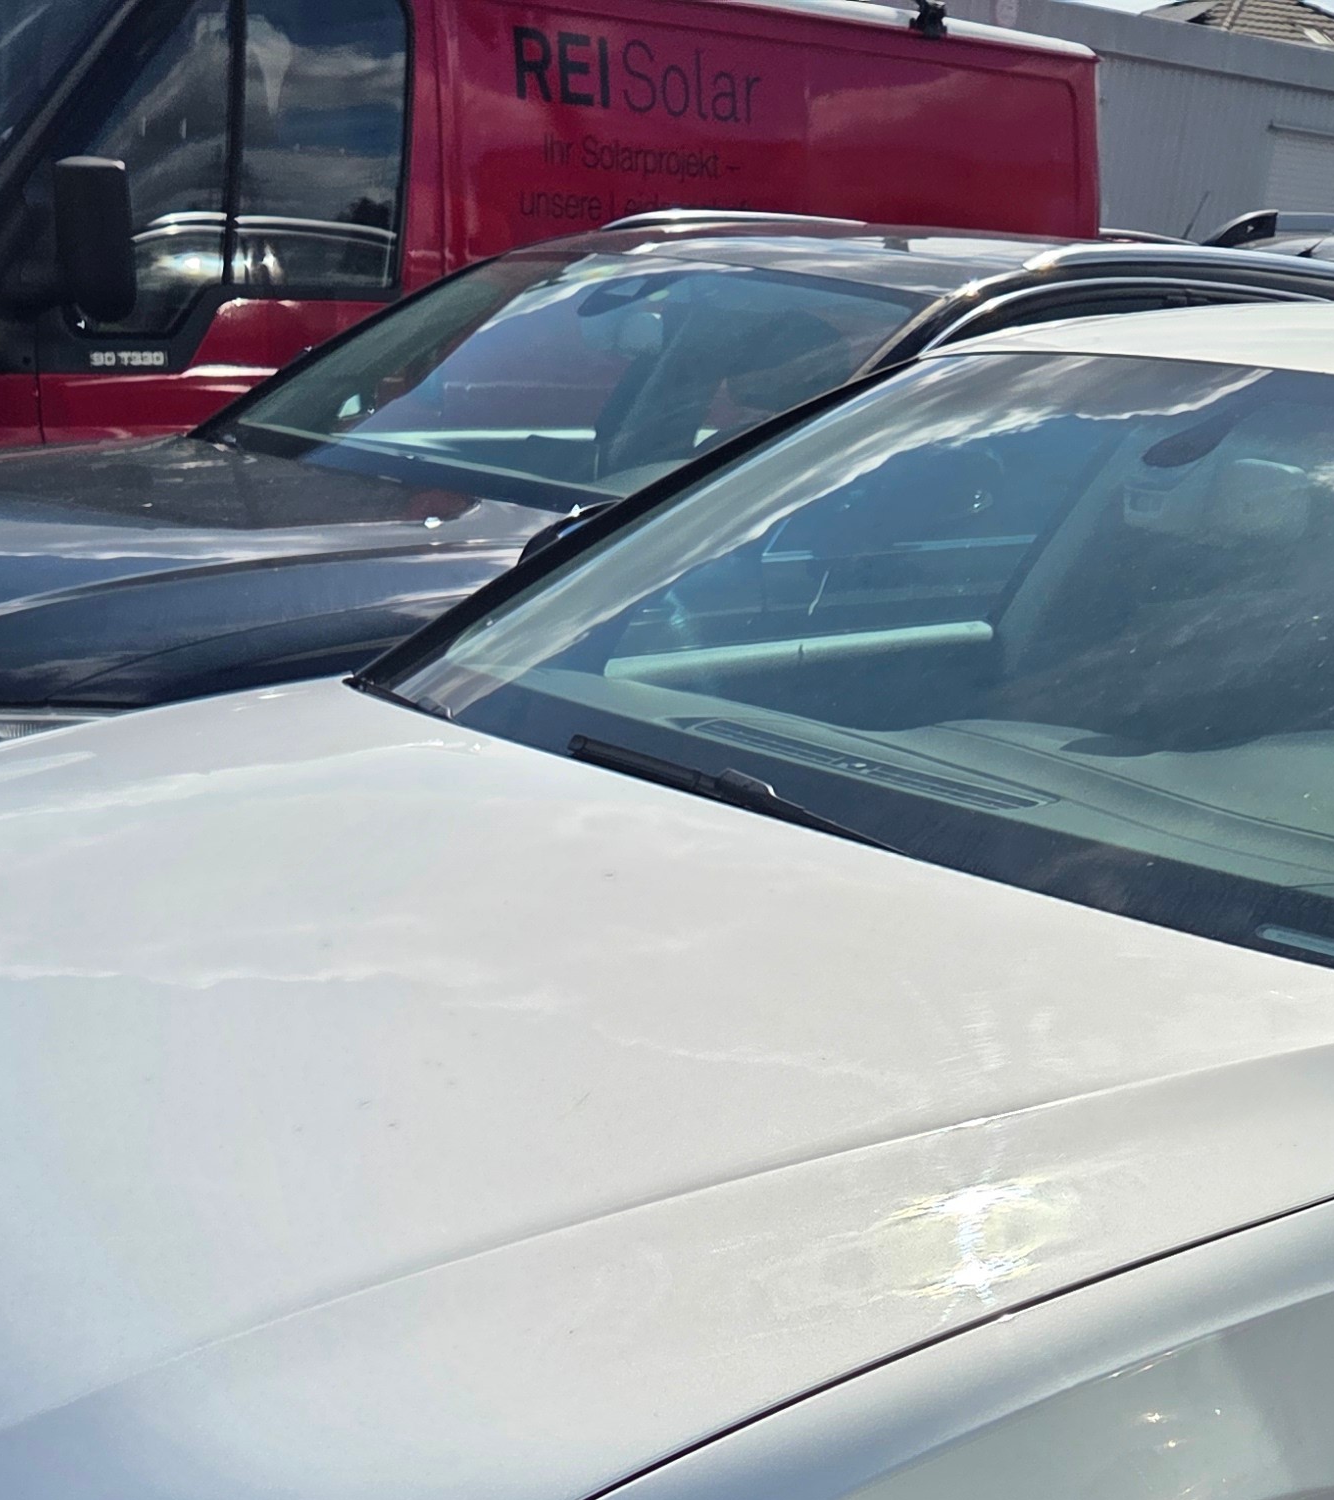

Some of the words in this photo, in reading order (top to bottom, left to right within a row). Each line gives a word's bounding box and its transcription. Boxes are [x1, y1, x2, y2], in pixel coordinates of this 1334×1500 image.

[513, 26, 610, 108] REI
[622, 39, 760, 124] Solar
[542, 133, 573, 166] Ihr
[581, 133, 720, 182] Solarprojekt
[519, 190, 602, 221] unsere
